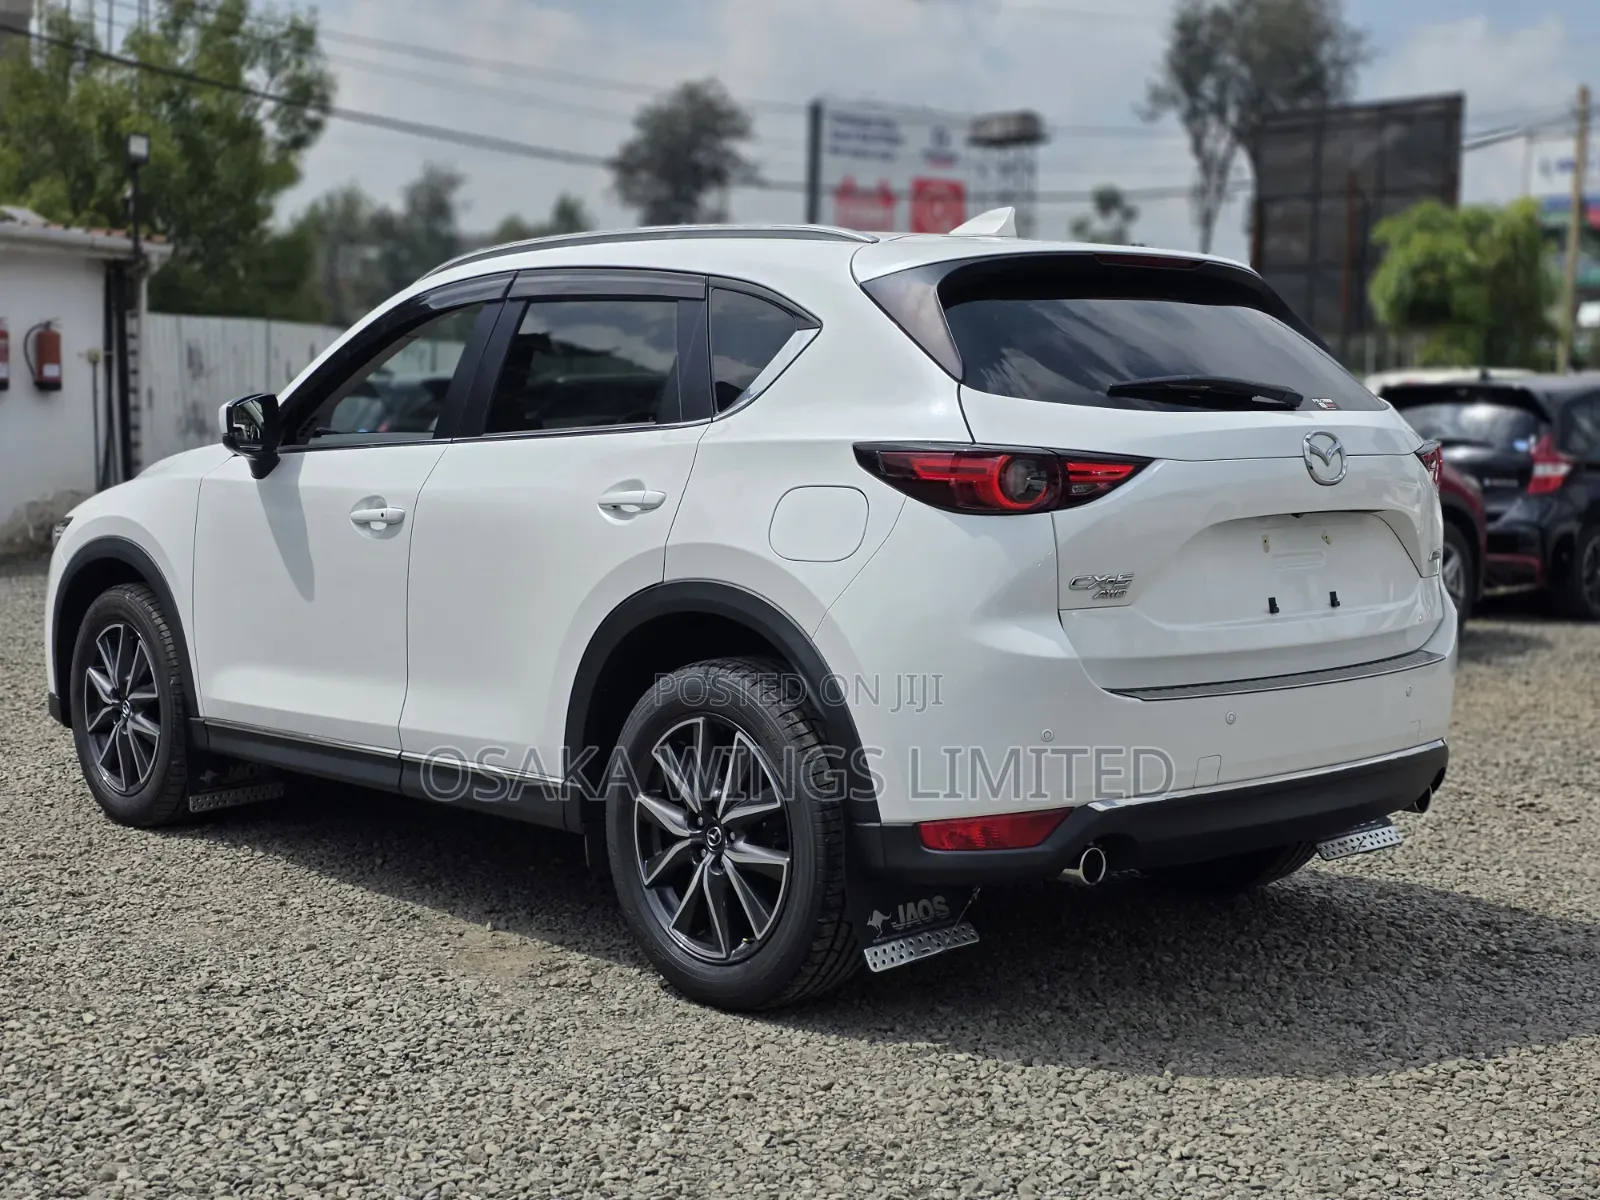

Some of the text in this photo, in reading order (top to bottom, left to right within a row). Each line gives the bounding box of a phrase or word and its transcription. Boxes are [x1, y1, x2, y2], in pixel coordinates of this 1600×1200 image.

[1069, 572, 1134, 590] CX-5
[1092, 588, 1128, 600] AWD
[891, 895, 950, 930] JAOS
